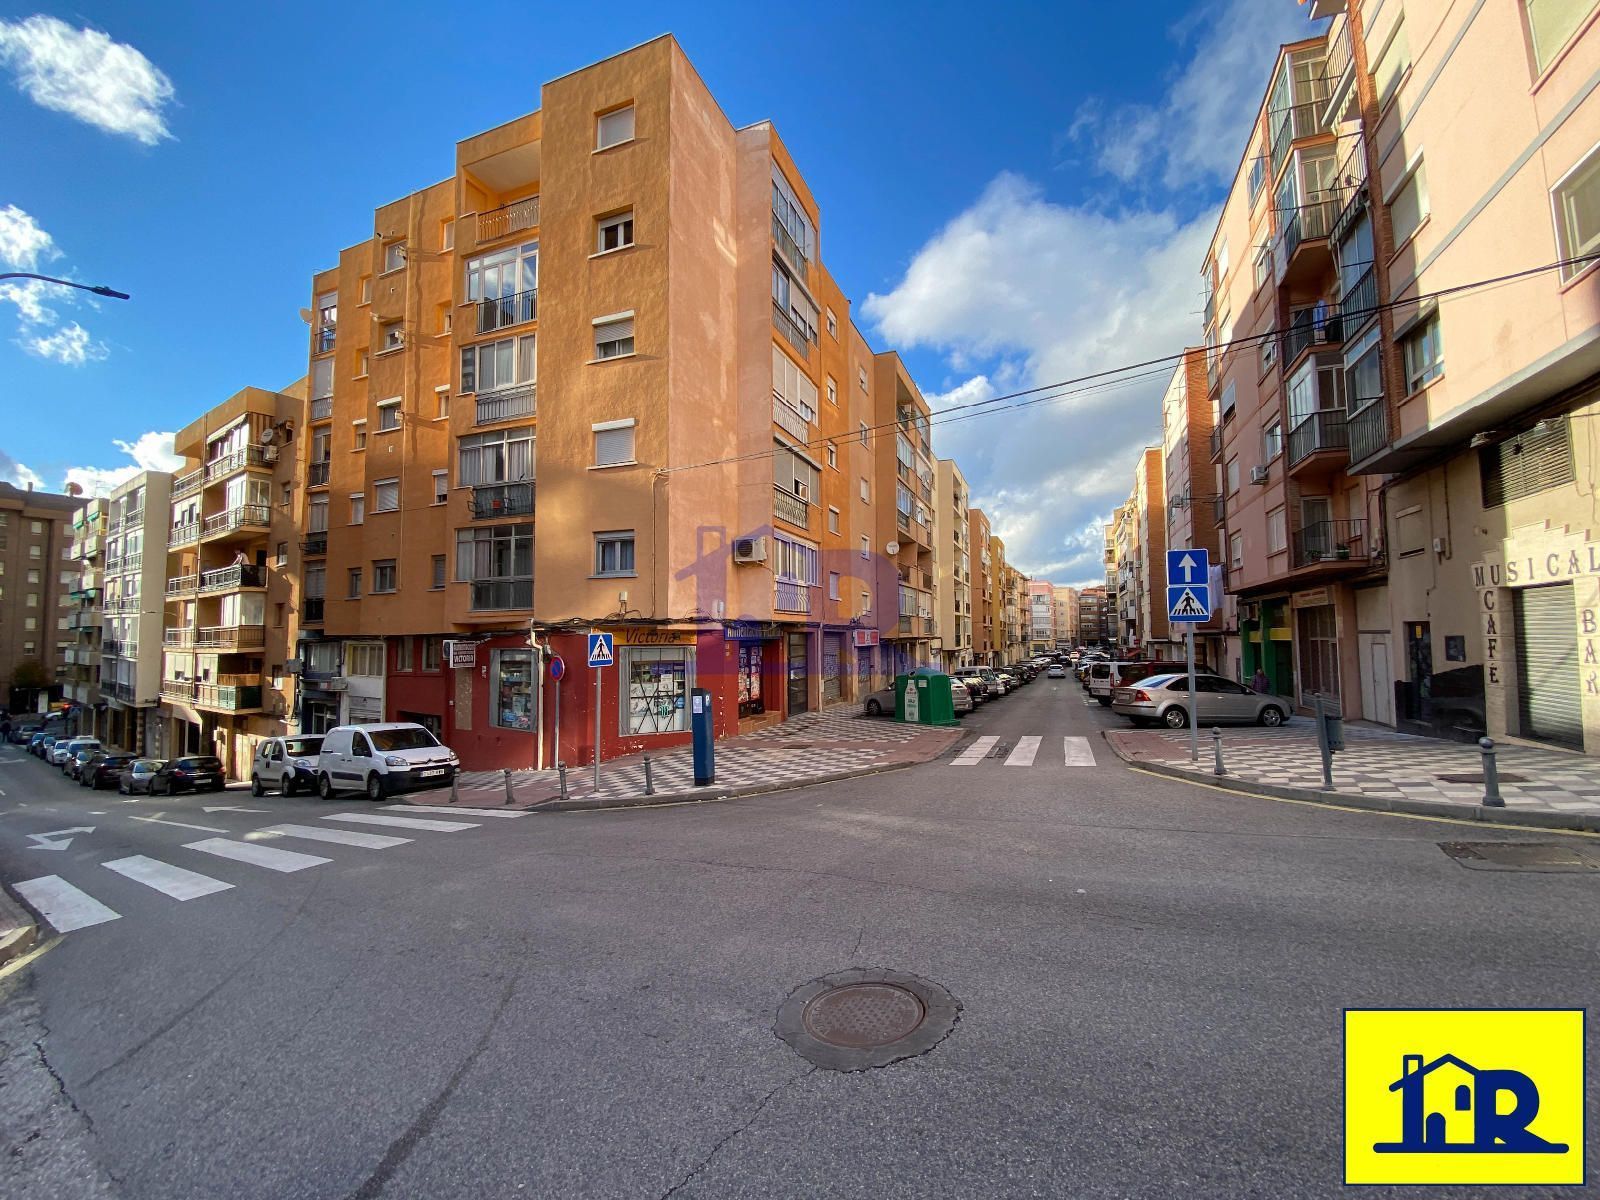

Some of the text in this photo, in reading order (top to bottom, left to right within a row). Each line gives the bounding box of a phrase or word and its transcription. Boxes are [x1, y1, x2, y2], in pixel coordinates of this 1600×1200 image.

[1475, 547, 1600, 587] MUSICAL
[625, 627, 676, 643] Victoria
[1484, 590, 1499, 684] CAFÉ
[1582, 609, 1599, 694] BAR
